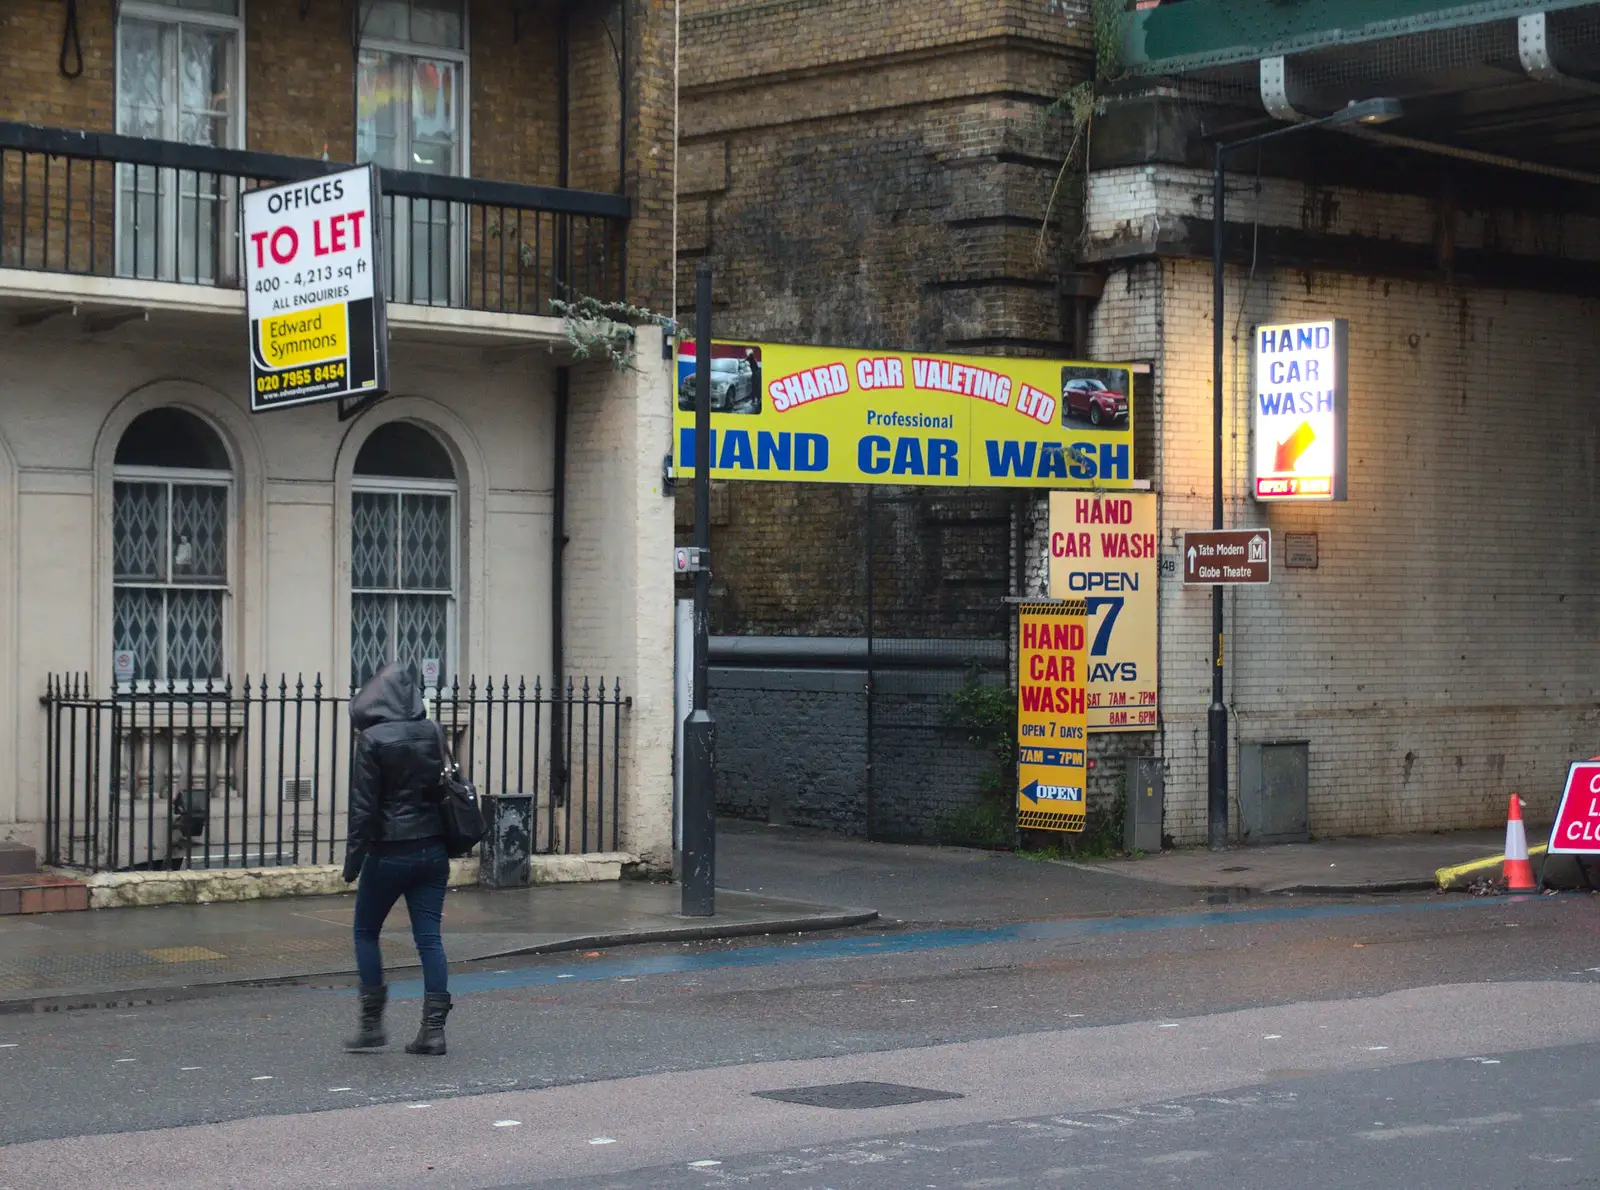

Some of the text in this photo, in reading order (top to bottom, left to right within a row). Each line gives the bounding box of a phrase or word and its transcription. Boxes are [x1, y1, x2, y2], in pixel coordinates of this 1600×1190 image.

[268, 179, 344, 214] OFFICES
[251, 210, 365, 268] TO LET
[255, 276, 280, 294] 400
[294, 265, 332, 288] 4,213
[338, 264, 352, 280] sq
[357, 258, 366, 274] ft
[272, 285, 350, 311] ALL ENQUIRIES
[270, 315, 322, 338] Edward
[1261, 326, 1330, 353] HAND
[271, 332, 337, 359] Symmons
[257, 363, 345, 392] 020 7955 8454
[1270, 359, 1319, 384] CAR
[768, 357, 1056, 425] SHARD CAR VALETING LTD
[1259, 390, 1333, 416] WASH
[867, 410, 953, 429] Professional
[858, 435, 958, 477] CAR
[985, 440, 1129, 480] WASH
[1076, 498, 1132, 524] HAND
[1052, 532, 1155, 558] CAR WASH
[1198, 544, 1245, 556] Tate Modern
[1069, 572, 1139, 591] OPEN
[1199, 566, 1252, 578] Globe Theatre
[1023, 623, 1084, 651] HAND
[1085, 596, 1124, 656] 7
[1030, 654, 1075, 682] CAR
[1088, 662, 1137, 683] AYS
[1021, 686, 1085, 714] WASH
[1087, 693, 1101, 706] SAT
[1109, 692, 1126, 706] 7AM
[1138, 691, 1156, 704] 7PM
[1022, 722, 1083, 739] OPEN 7 DAYS
[1109, 712, 1127, 724] 8AM
[1138, 711, 1156, 723] 6PM
[1020, 749, 1043, 763] 7AM
[1059, 752, 1083, 765] 7PM
[1036, 785, 1079, 801] OPEN
